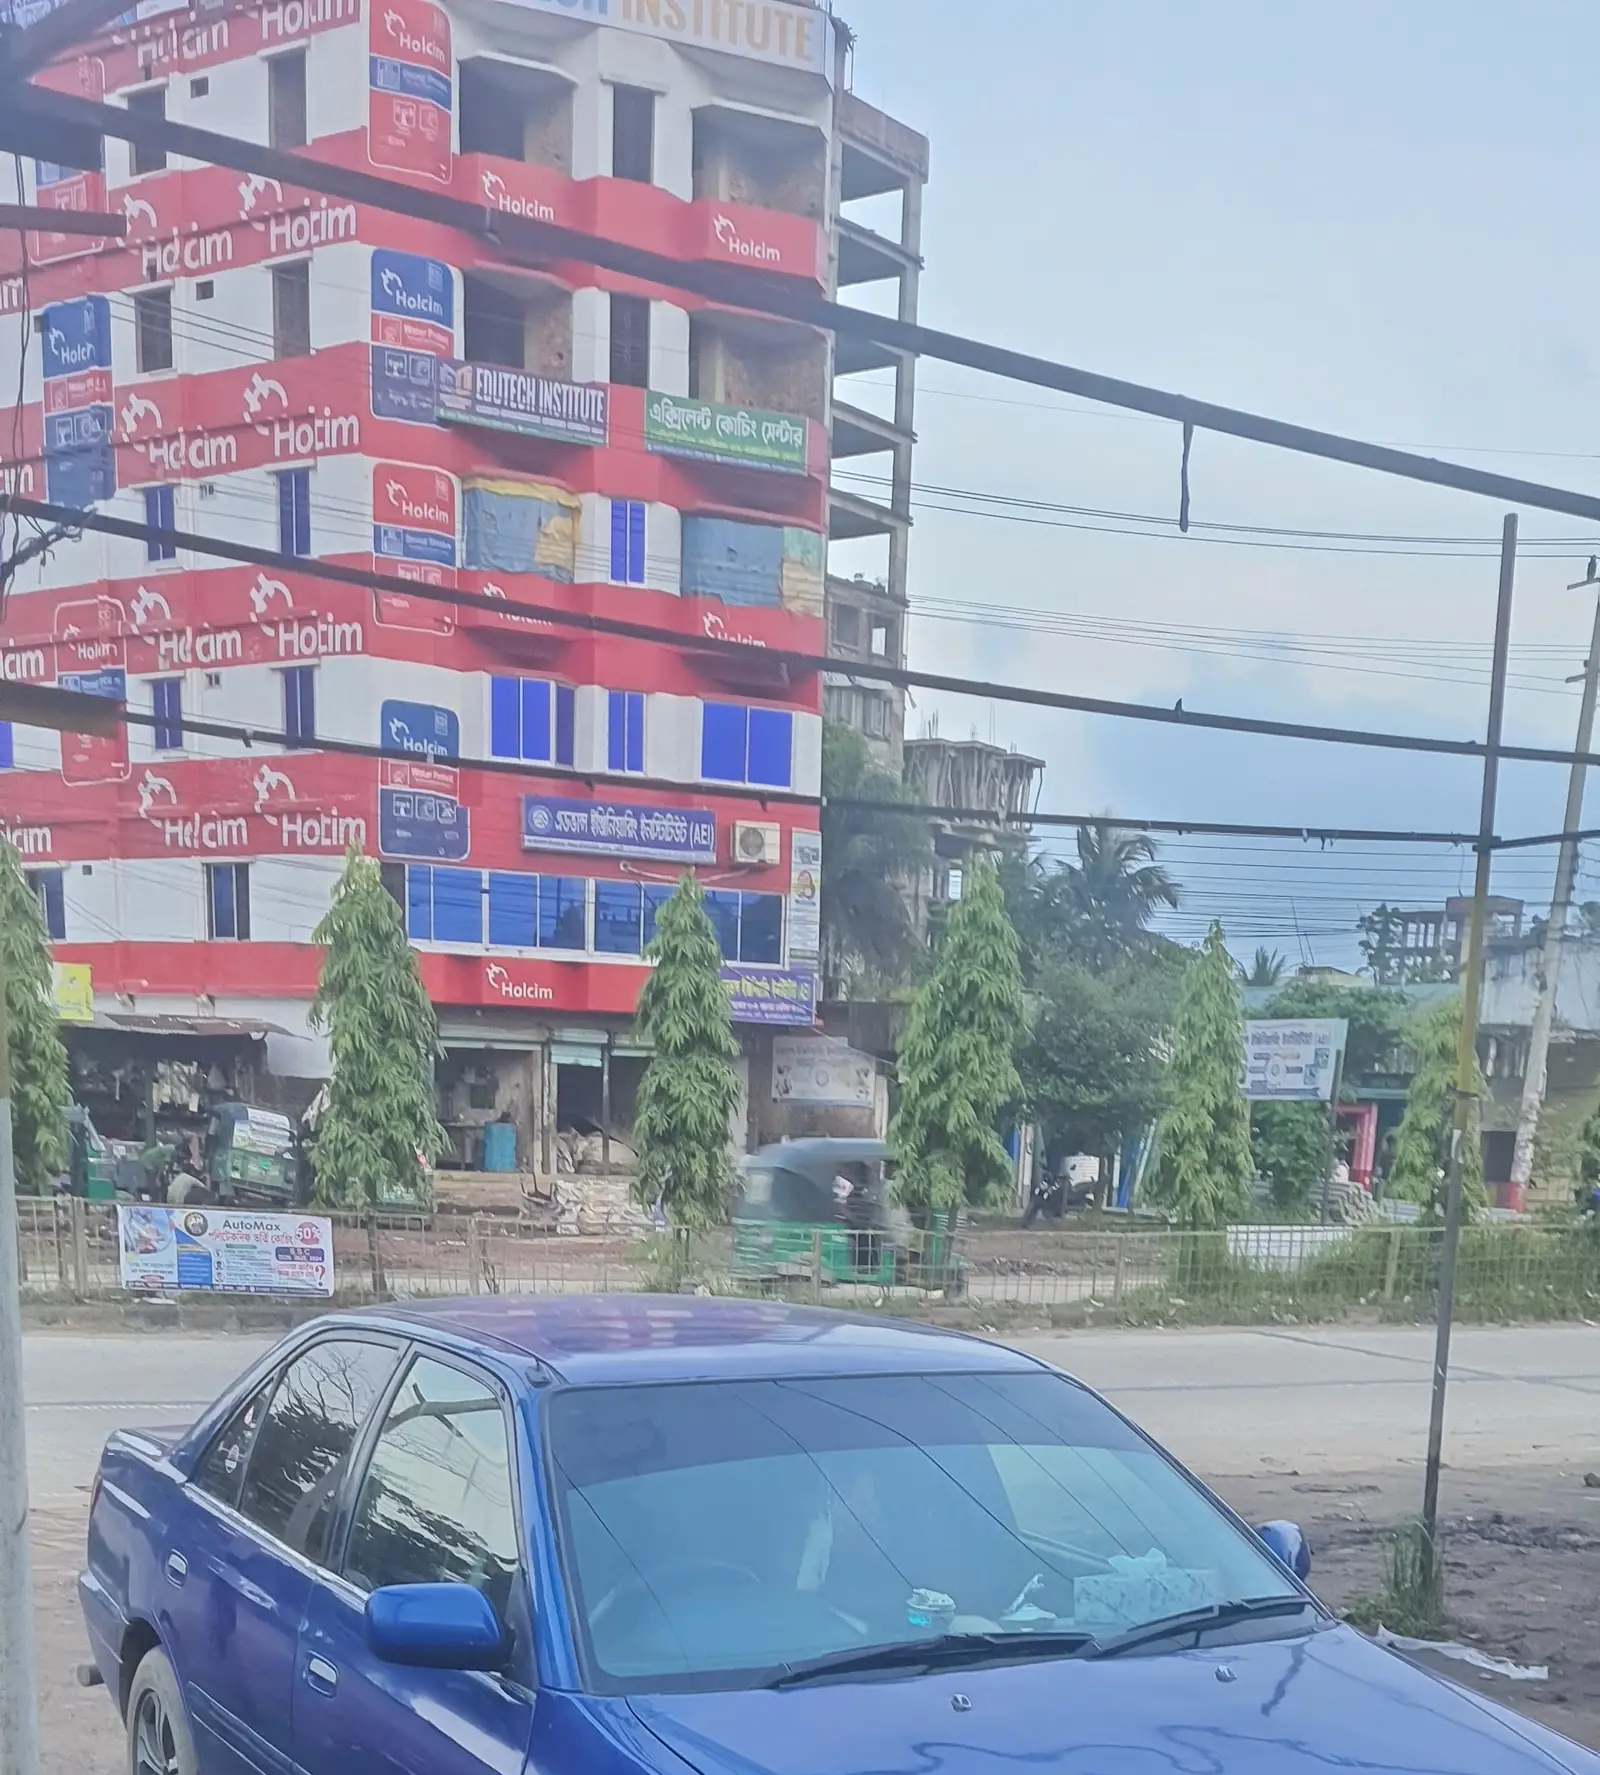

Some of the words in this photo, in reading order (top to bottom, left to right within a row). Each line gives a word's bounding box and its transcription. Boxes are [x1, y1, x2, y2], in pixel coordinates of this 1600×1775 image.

[400, 32, 445, 64] Holcim
[499, 196, 555, 221] Holcim
[729, 237, 780, 262] Holcim
[395, 289, 443, 317] Holcim
[476, 367, 535, 413] EDUTECH
[538, 378, 605, 423] INSTITUTE
[715, 410, 757, 439] কোচিং
[761, 420, 803, 448] সেন্টার
[402, 502, 449, 525] Holcim
[403, 737, 448, 757] Holcim
[689, 820, 715, 850] (AEI)
[501, 980, 553, 1000] Holcim
[222, 1219, 281, 1232] AutoMax
